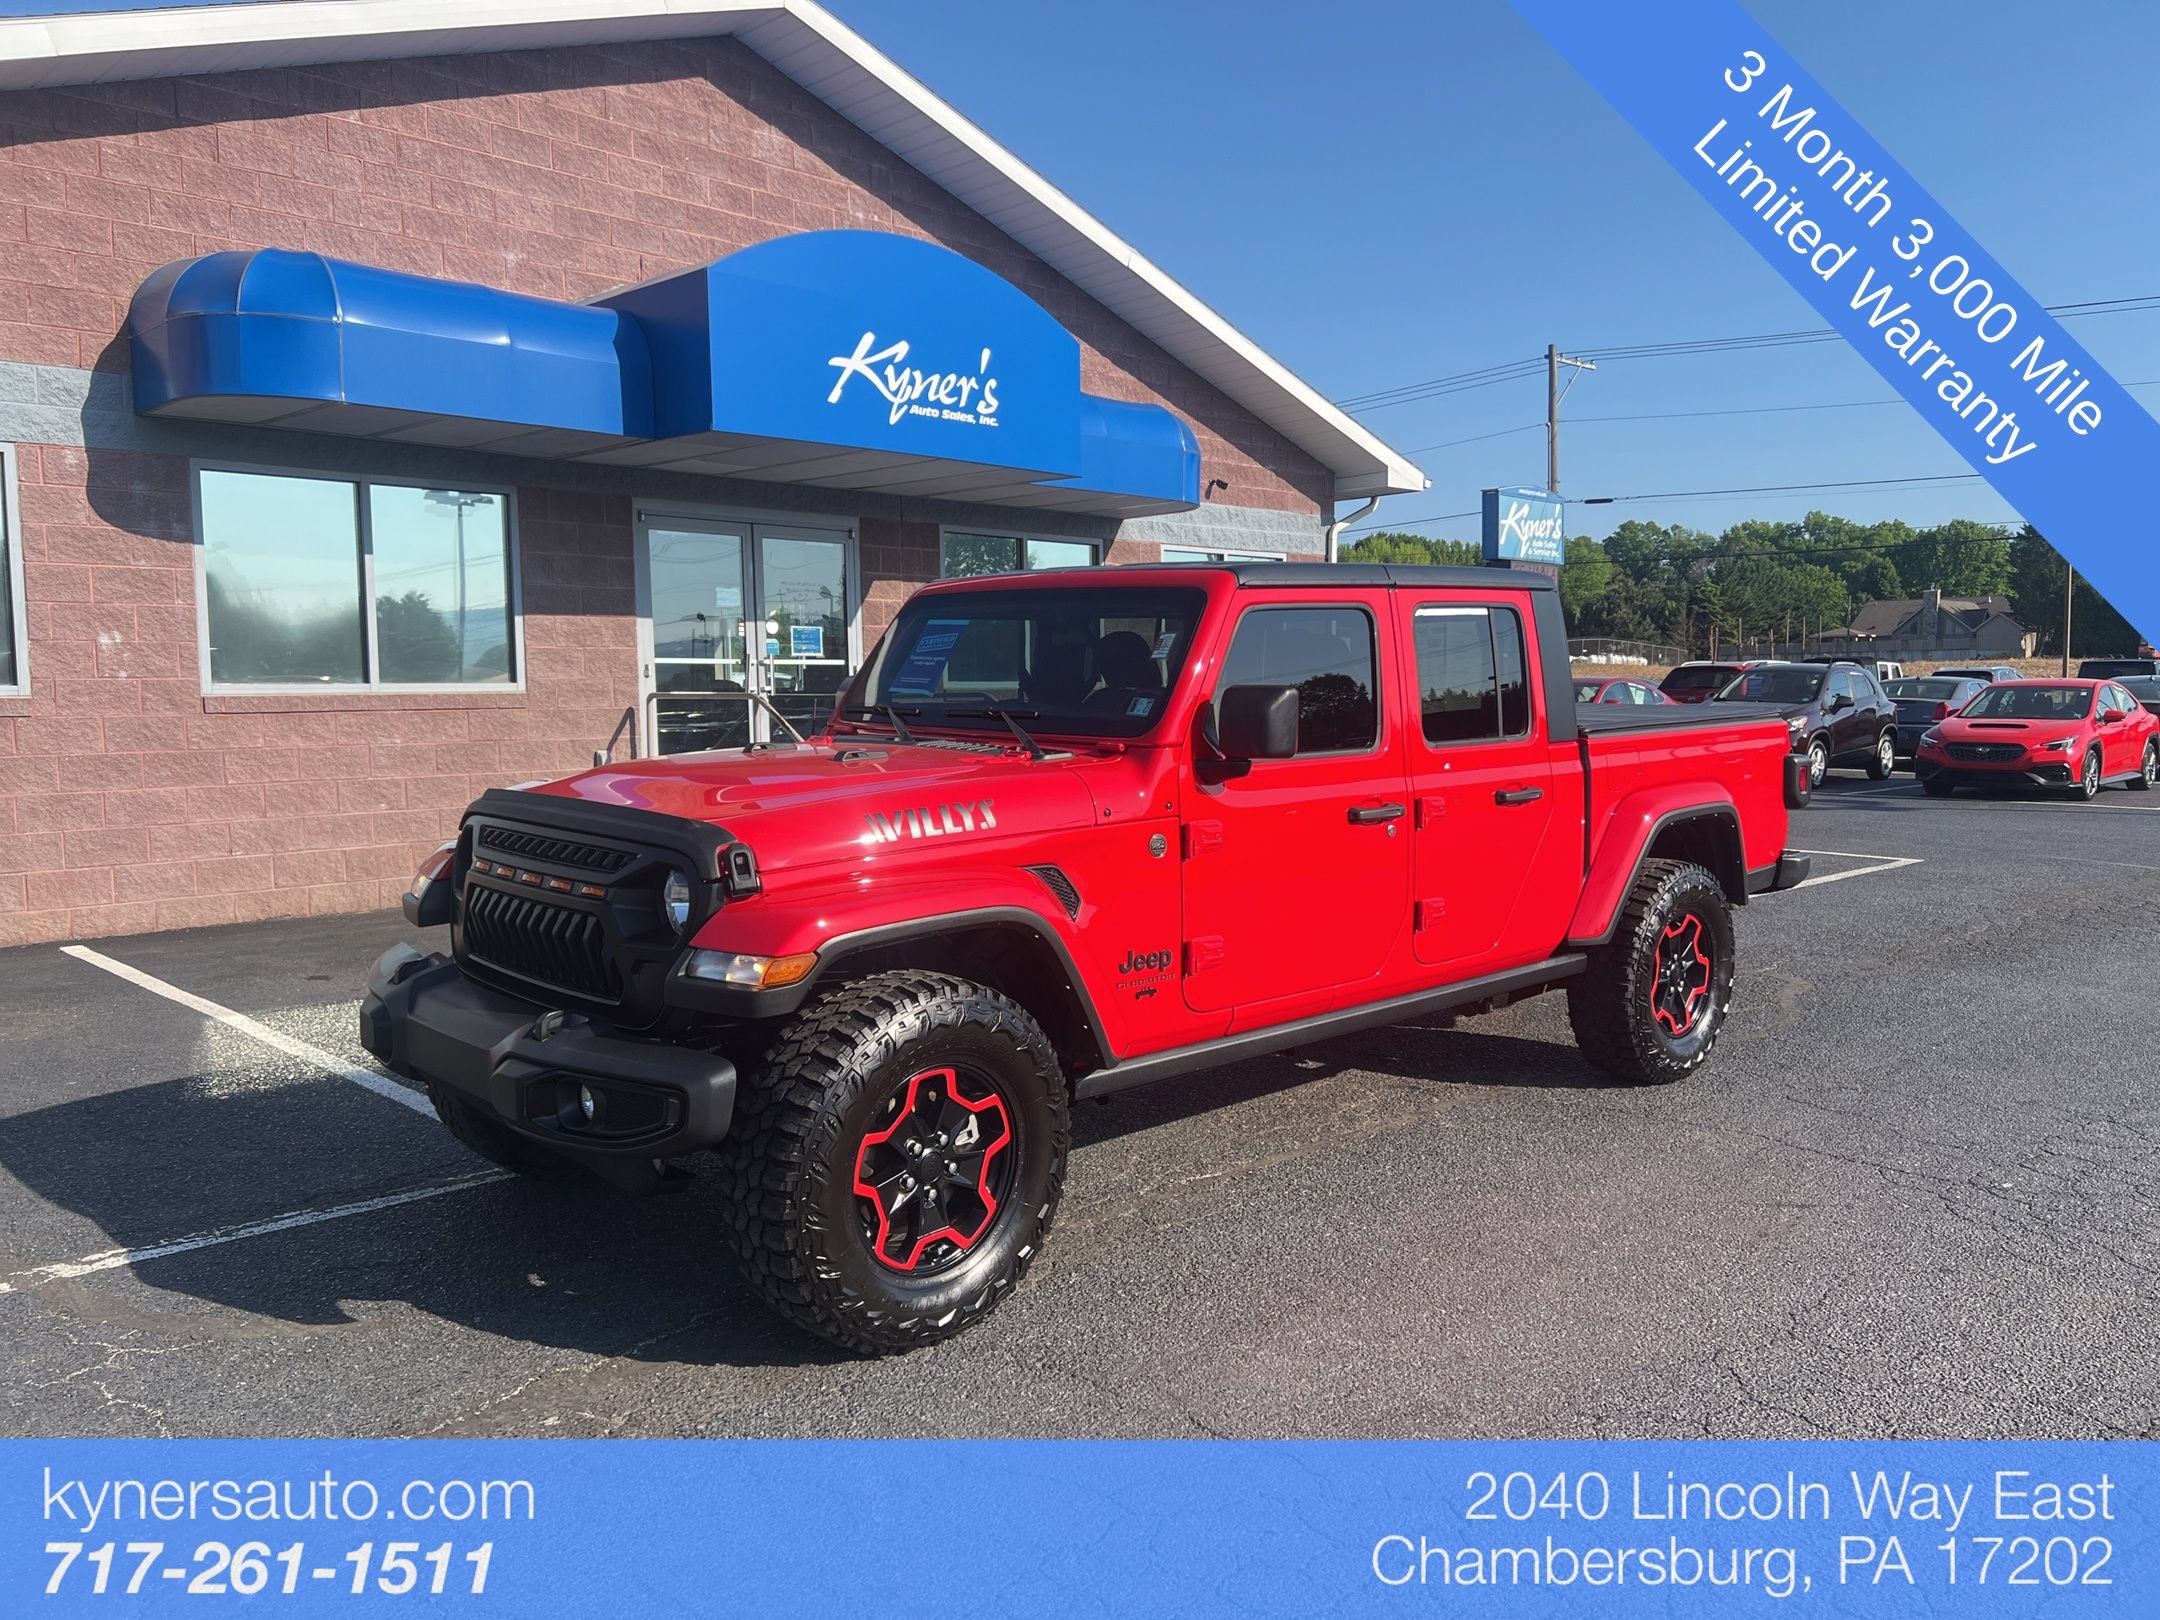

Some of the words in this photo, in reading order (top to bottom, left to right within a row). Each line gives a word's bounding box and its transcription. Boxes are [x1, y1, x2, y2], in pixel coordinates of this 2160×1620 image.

[827, 331, 999, 425] Kyner's
[909, 404, 939, 417] Auto
[941, 409, 976, 424] Sales,
[979, 415, 999, 427] Inc.
[1500, 501, 1562, 558] Kyner's
[864, 800, 997, 843] WILLYS
[1119, 950, 1172, 974] Jeep
